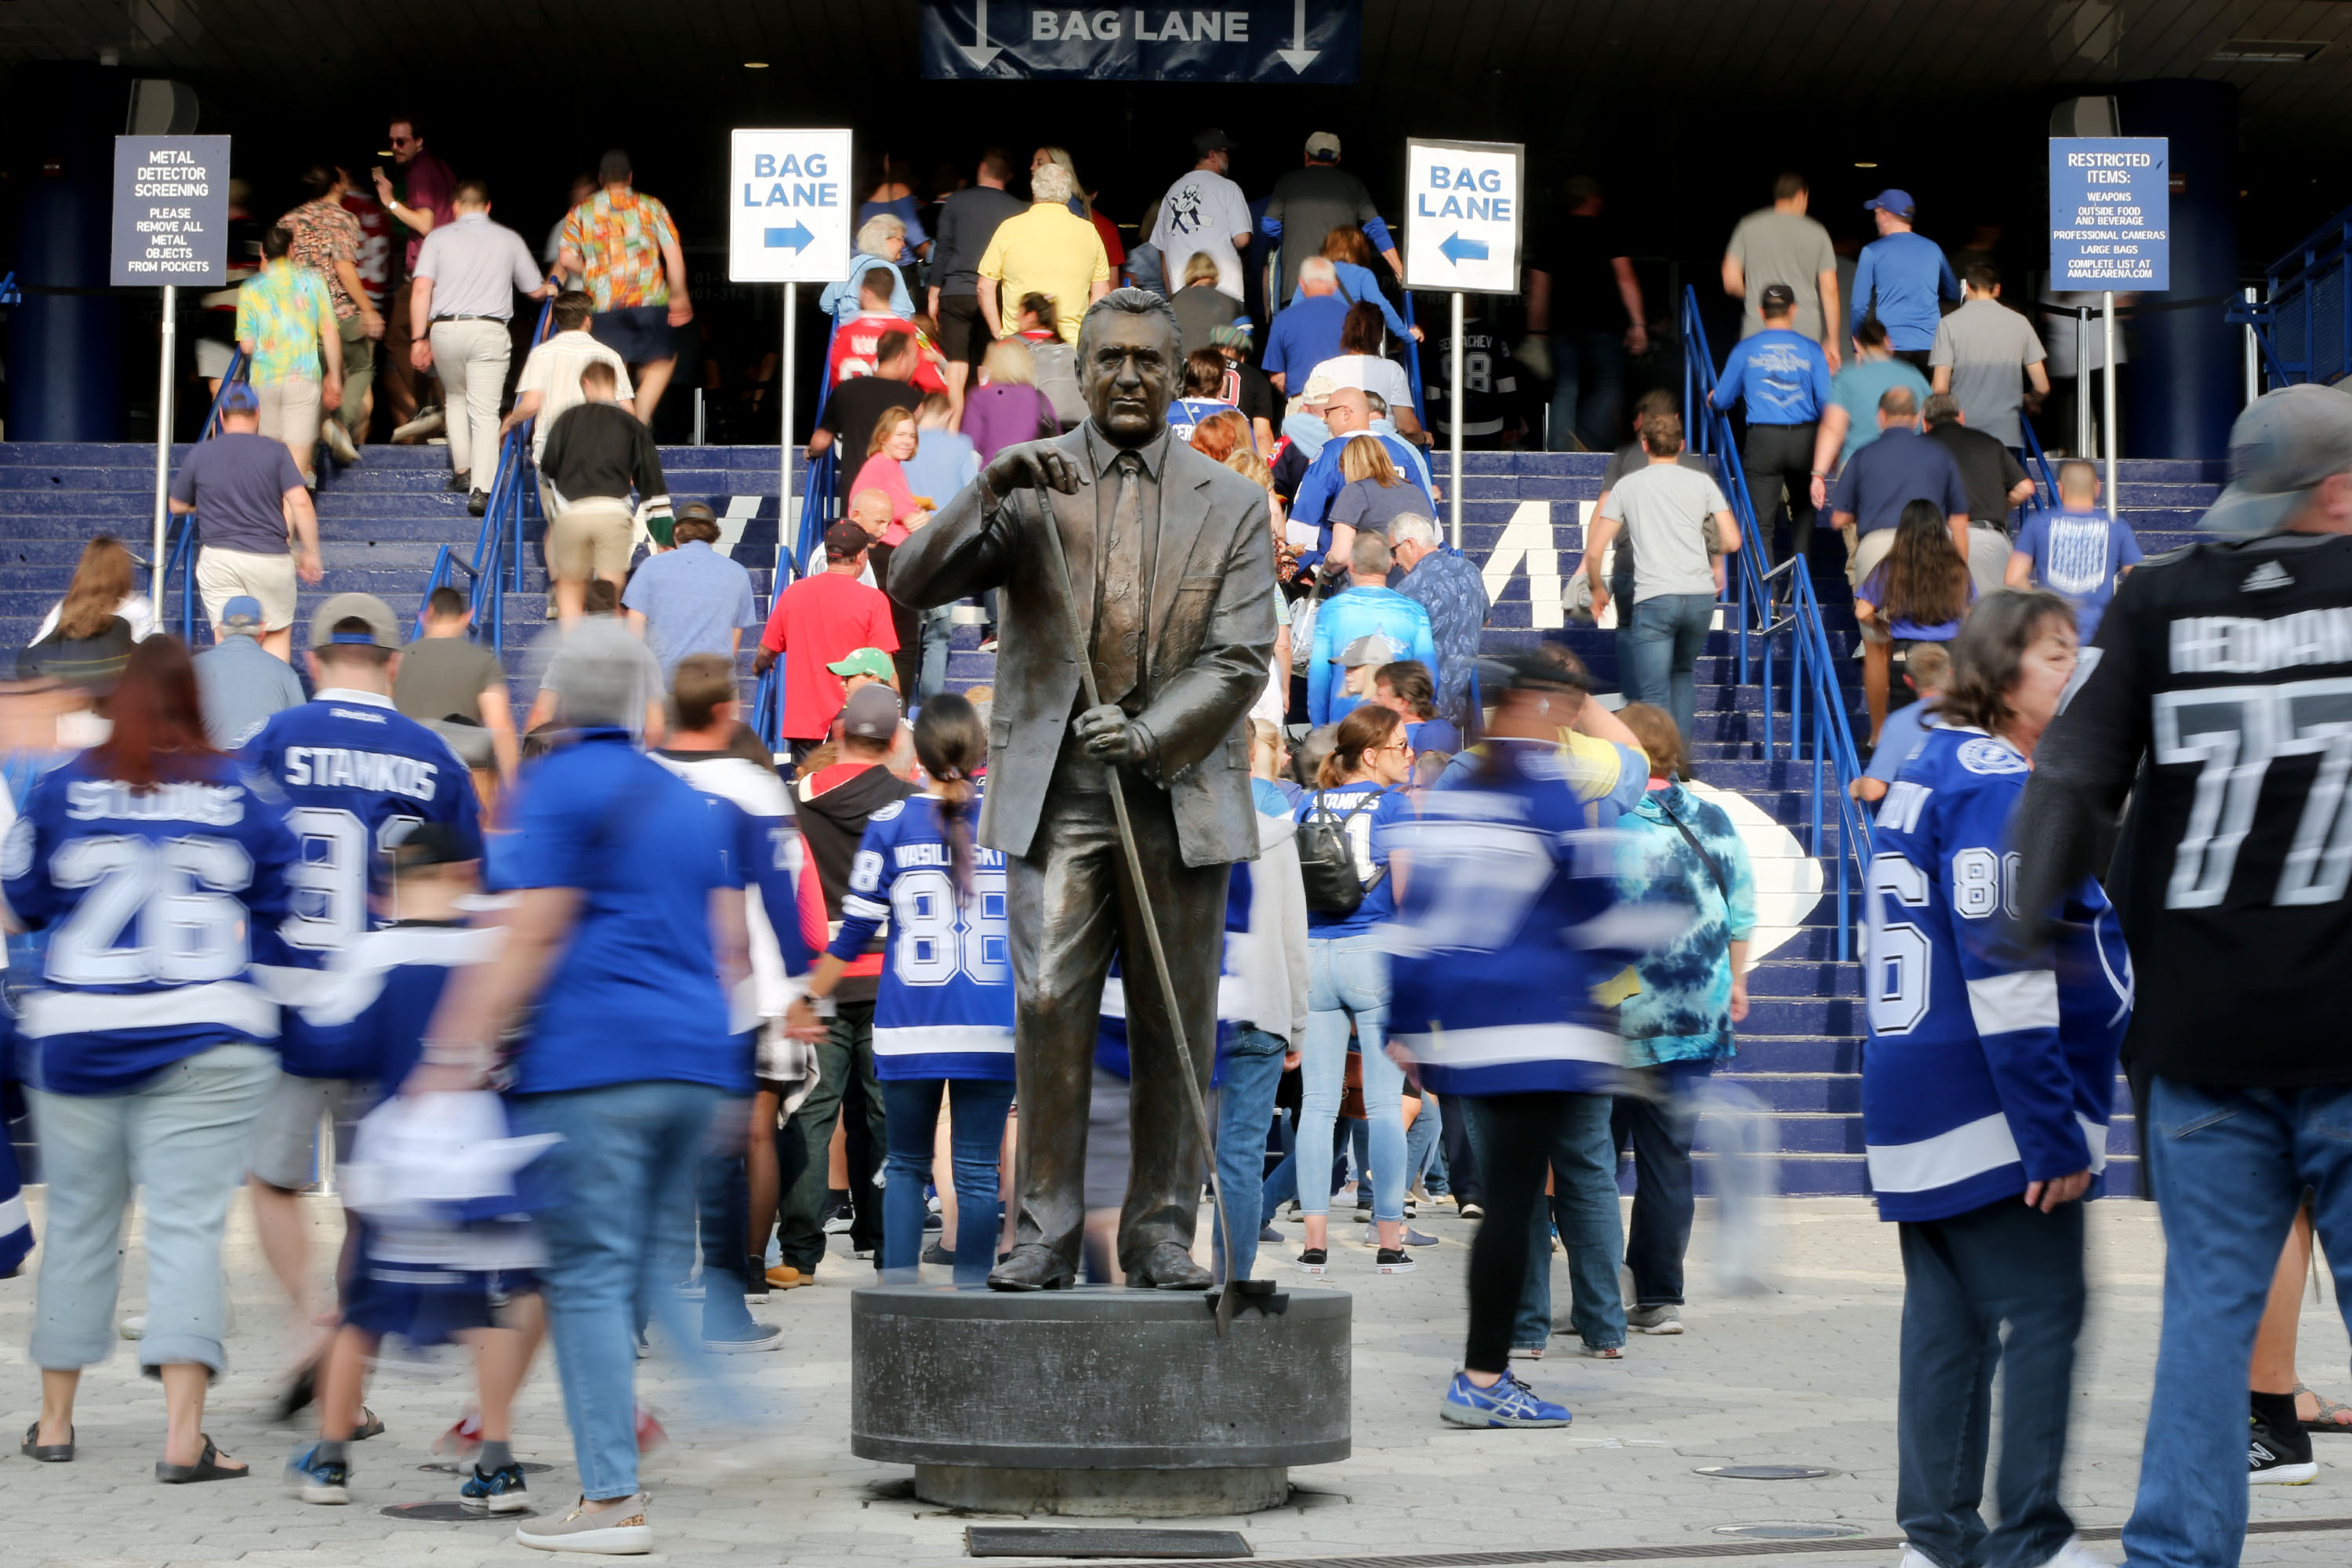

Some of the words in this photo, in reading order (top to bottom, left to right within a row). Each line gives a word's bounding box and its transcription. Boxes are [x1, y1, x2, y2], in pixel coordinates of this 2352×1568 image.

[1032, 10, 1120, 42] BAG
[1134, 10, 1249, 42] LANE
[149, 151, 195, 164] METAL
[2067, 153, 2151, 167] RESTRICTED
[754, 153, 828, 178] BAG
[137, 167, 206, 180] DETECTOR
[1429, 165, 1501, 193] BAG
[2087, 170, 2131, 183] ITEMS:
[134, 183, 209, 197] SCREENING
[743, 183, 838, 207] LANE
[2087, 192, 2132, 201] WEAPONS
[150, 208, 191, 219] PLEASE
[1417, 193, 1512, 222] LANE
[2078, 206, 2114, 216] OUTSIDE
[2118, 206, 2141, 216] FOOD
[136, 221, 179, 232] REMOVE
[183, 221, 204, 232] ALL
[2074, 216, 2095, 225] AND
[2097, 216, 2144, 226] BEVERAGE
[151, 234, 187, 245] METAL
[2053, 230, 2119, 240] PROFESSIONAL
[2122, 230, 2166, 240] CAMERAS
[146, 248, 193, 259] OBJECTS
[2081, 245, 2111, 254] LARGE
[2113, 245, 2138, 254] BAGS
[128, 261, 158, 272] FROM
[161, 261, 209, 272] POCKETS
[2068, 260, 2114, 268] COMPLETE
[2117, 260, 2136, 268] LIST
[2138, 260, 2151, 268] AT
[2067, 269, 2153, 278] AMALIEARENA.COM
[285, 746, 439, 802] STAMKOS
[42, 833, 256, 986] 26
